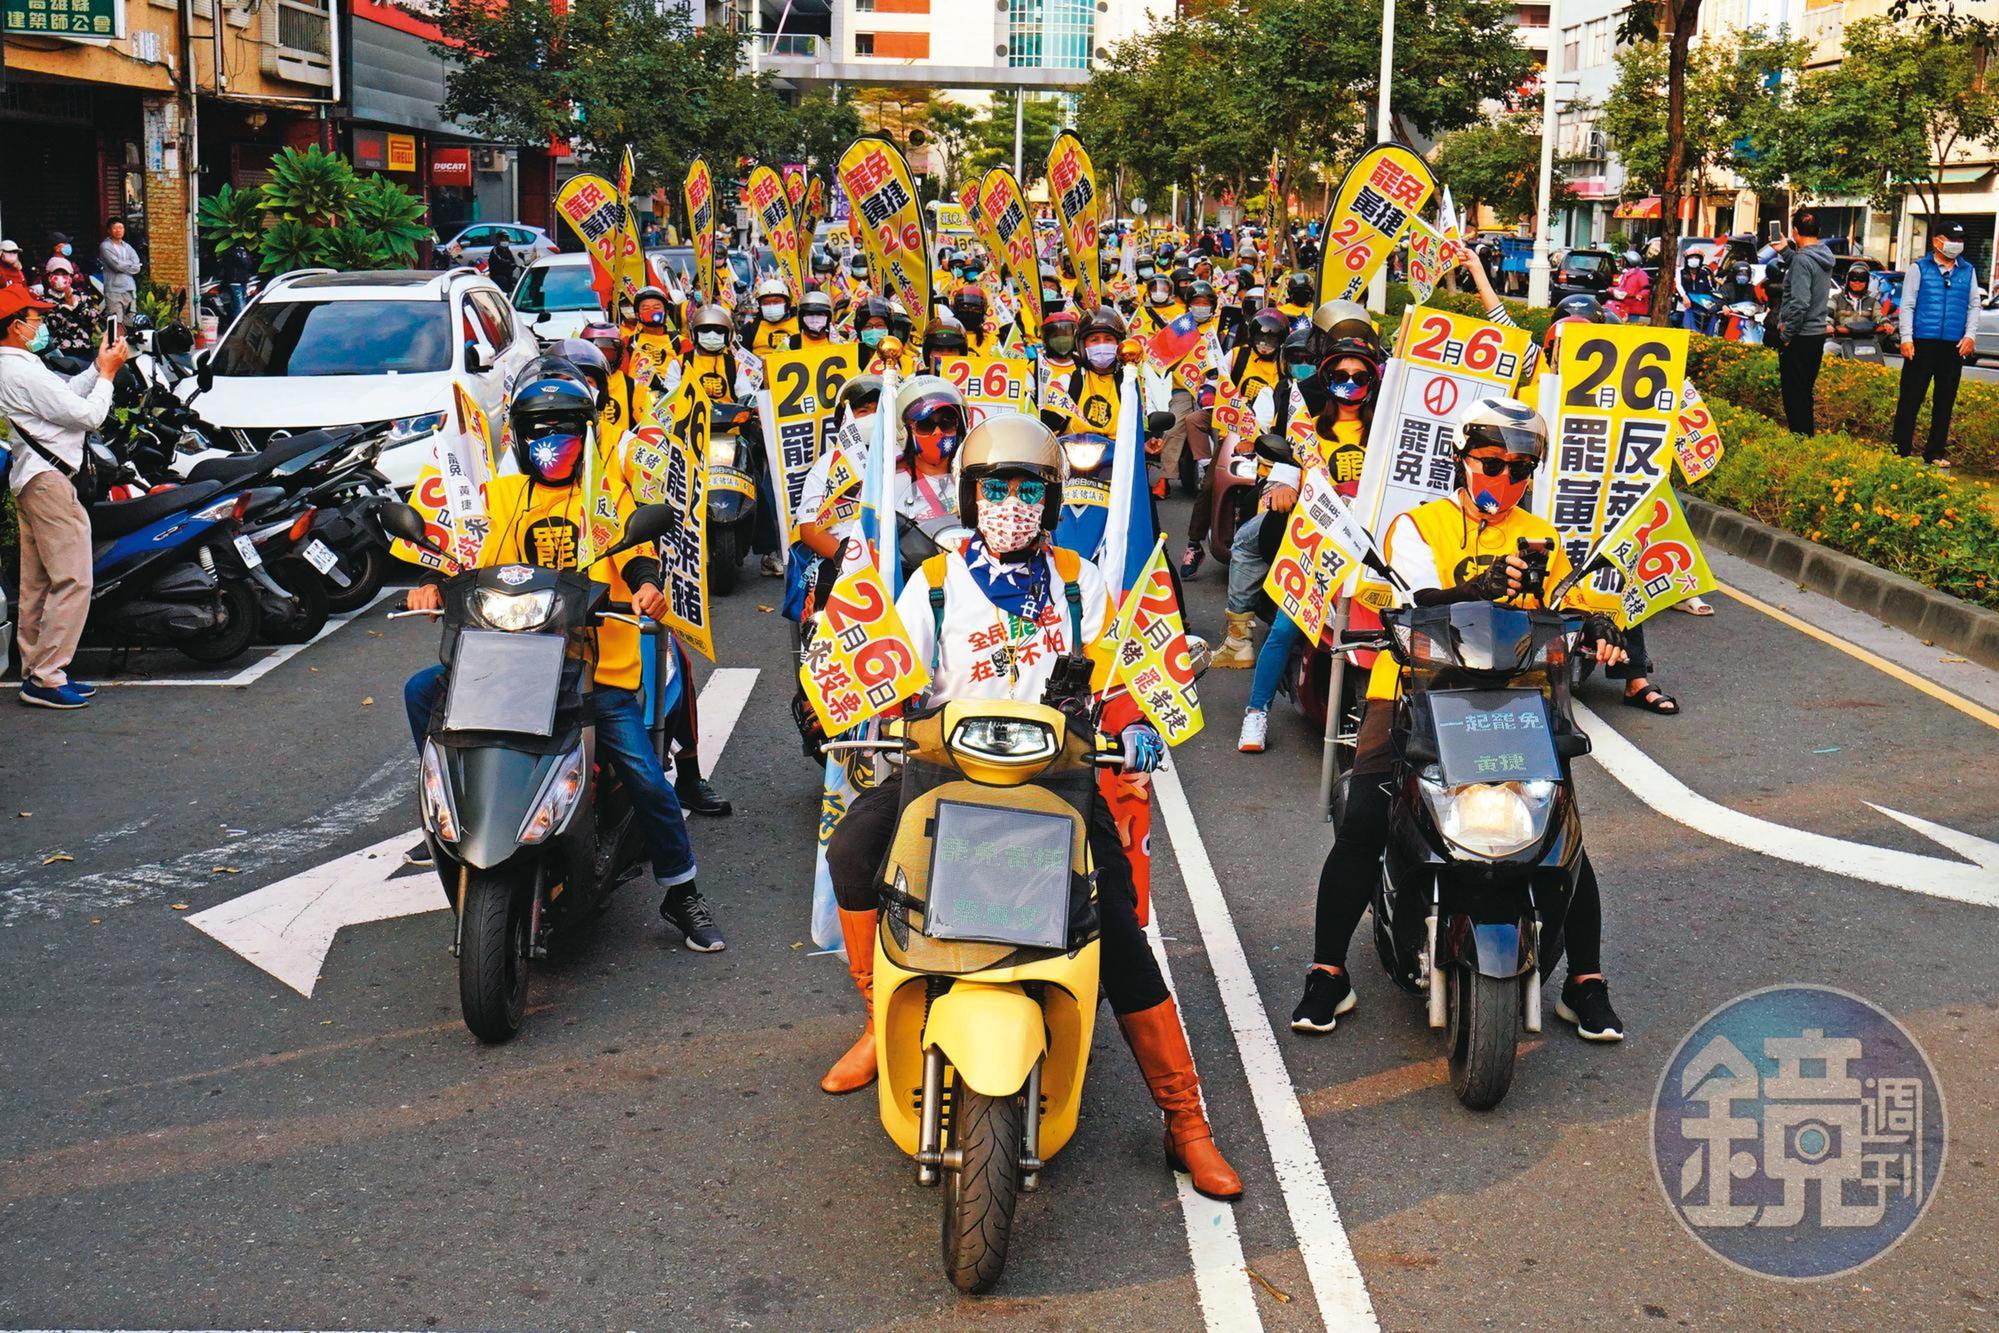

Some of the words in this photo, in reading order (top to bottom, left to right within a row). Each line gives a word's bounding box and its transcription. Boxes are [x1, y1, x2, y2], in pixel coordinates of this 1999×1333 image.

[7, 11, 111, 33] 建築師公會
[434, 162, 467, 170] DUCATI
[752, 175, 780, 208] 罷免
[845, 150, 893, 200] 罷免
[1052, 146, 1081, 198] 罷免
[1369, 157, 1426, 210] 罷免
[563, 182, 606, 222] 罷免
[762, 196, 789, 232] 黃捷
[860, 179, 911, 230] 黃捷
[984, 178, 1013, 222] 罷免
[996, 199, 1025, 245] 黃捷
[1061, 173, 1093, 228] 黃捷
[1350, 185, 1407, 239] 黃捷
[1412, 317, 1517, 378] 2月6日
[949, 362, 1021, 399] 2月6日
[1565, 338, 1673, 411] 2月6日
[1393, 418, 1432, 487] 罷免
[1678, 409, 1719, 470] 2月6日
[1336, 450, 1365, 481] 罷
[825, 582, 913, 709] 2月6日
[806, 640, 862, 723] 來投票
